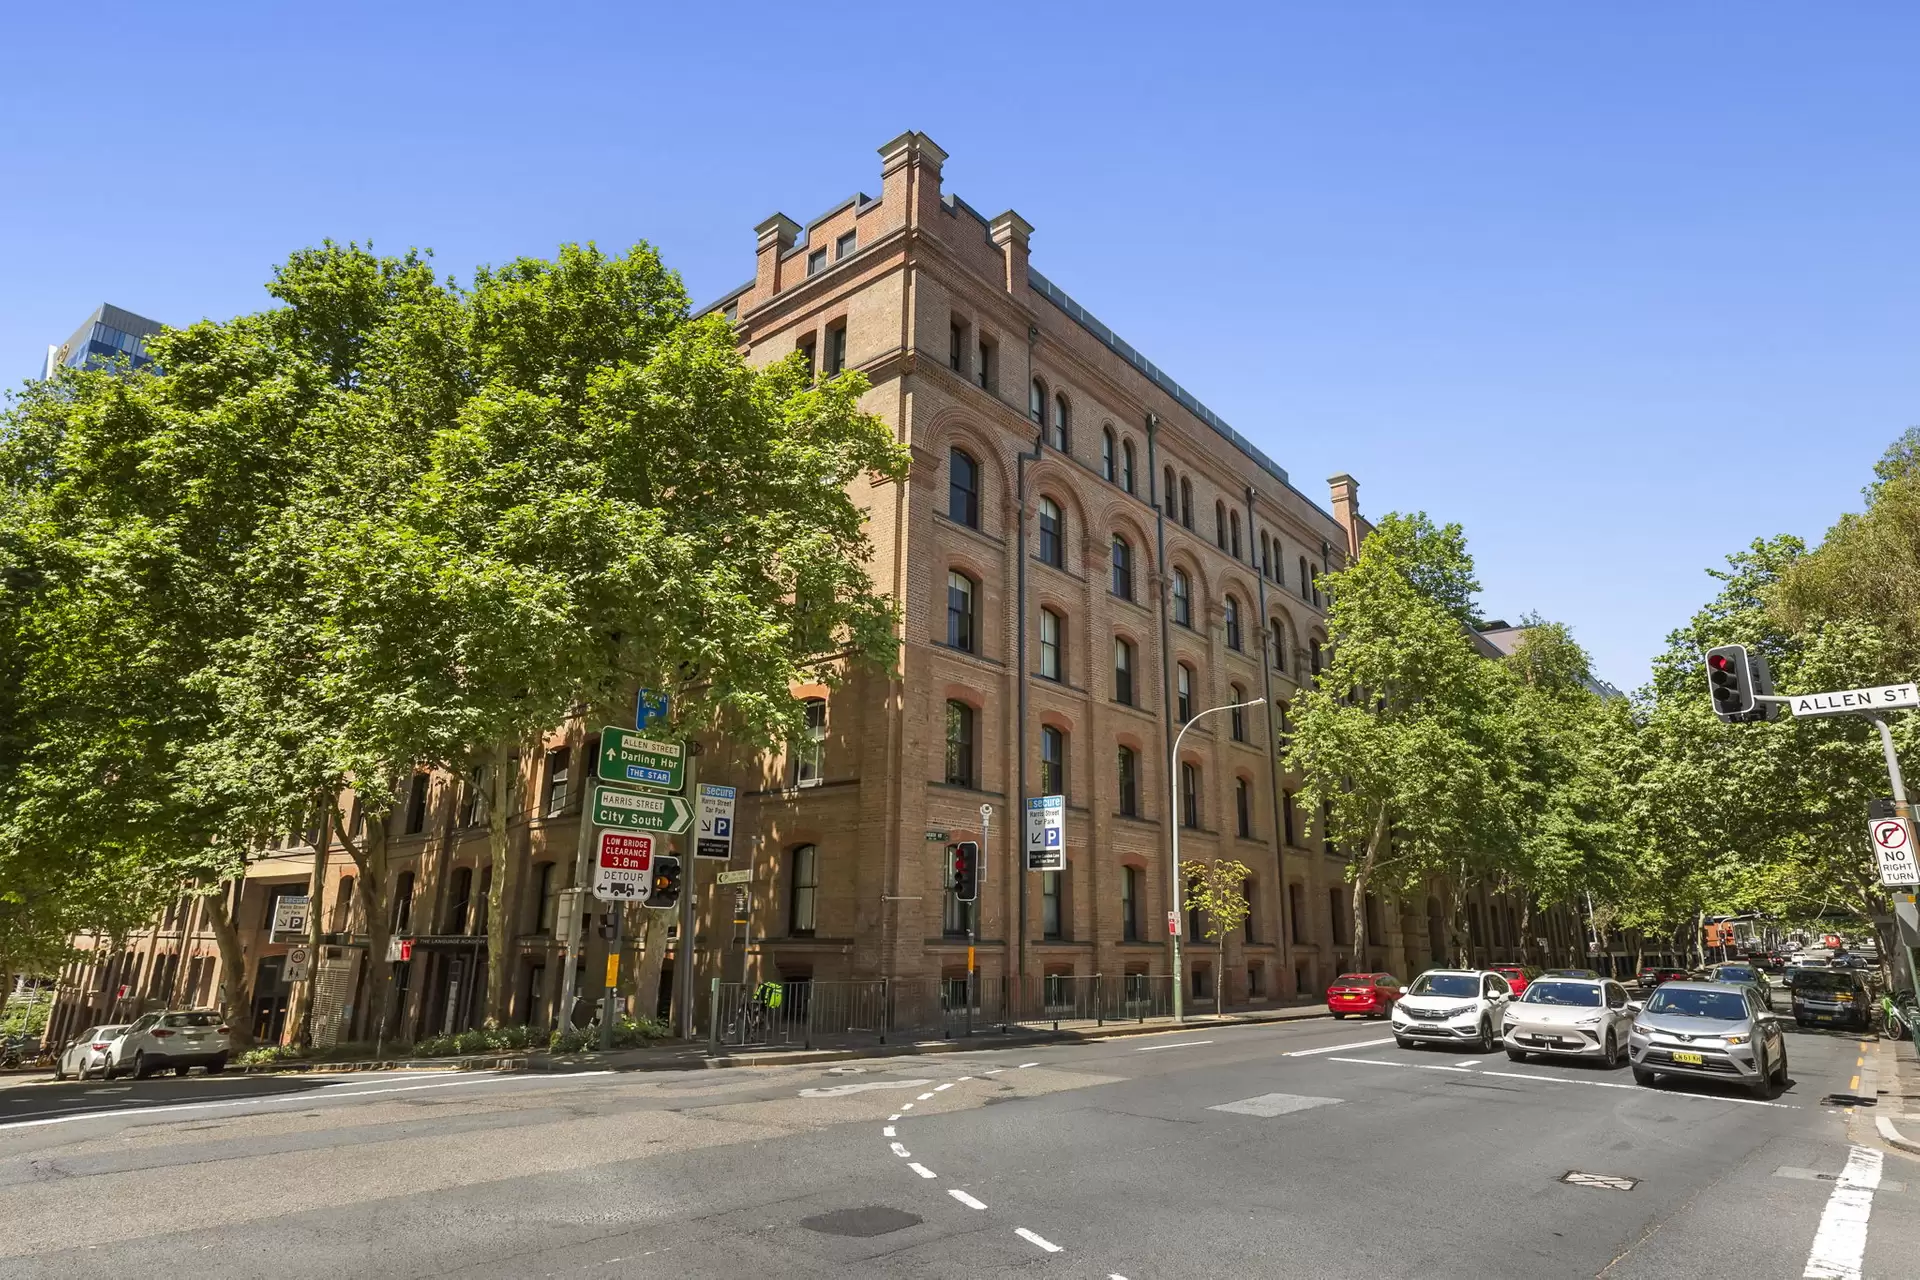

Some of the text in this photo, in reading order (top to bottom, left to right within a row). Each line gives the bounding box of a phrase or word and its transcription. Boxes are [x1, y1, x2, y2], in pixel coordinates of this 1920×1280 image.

[1799, 688, 1910, 711] ALLEN ST
[624, 739, 678, 755] ALLEN STREET
[621, 750, 678, 768] Darling Hbr
[630, 768, 667, 780] THE STAR
[706, 787, 733, 798] secure
[603, 795, 663, 810] HARRIS STREET
[717, 799, 732, 807] Street
[1033, 798, 1060, 808] secure
[600, 810, 663, 827] City South
[717, 820, 727, 834] P
[606, 837, 648, 849] LOW BRIDGE
[1048, 830, 1057, 844] P
[605, 847, 647, 857] CLEARANCE
[1885, 850, 1906, 861] NO
[612, 856, 639, 868] 3.8m
[1883, 863, 1912, 872] RIGHT
[604, 871, 644, 881] DETOUR
[1886, 872, 1914, 881] TURN
[292, 918, 301, 927] P
